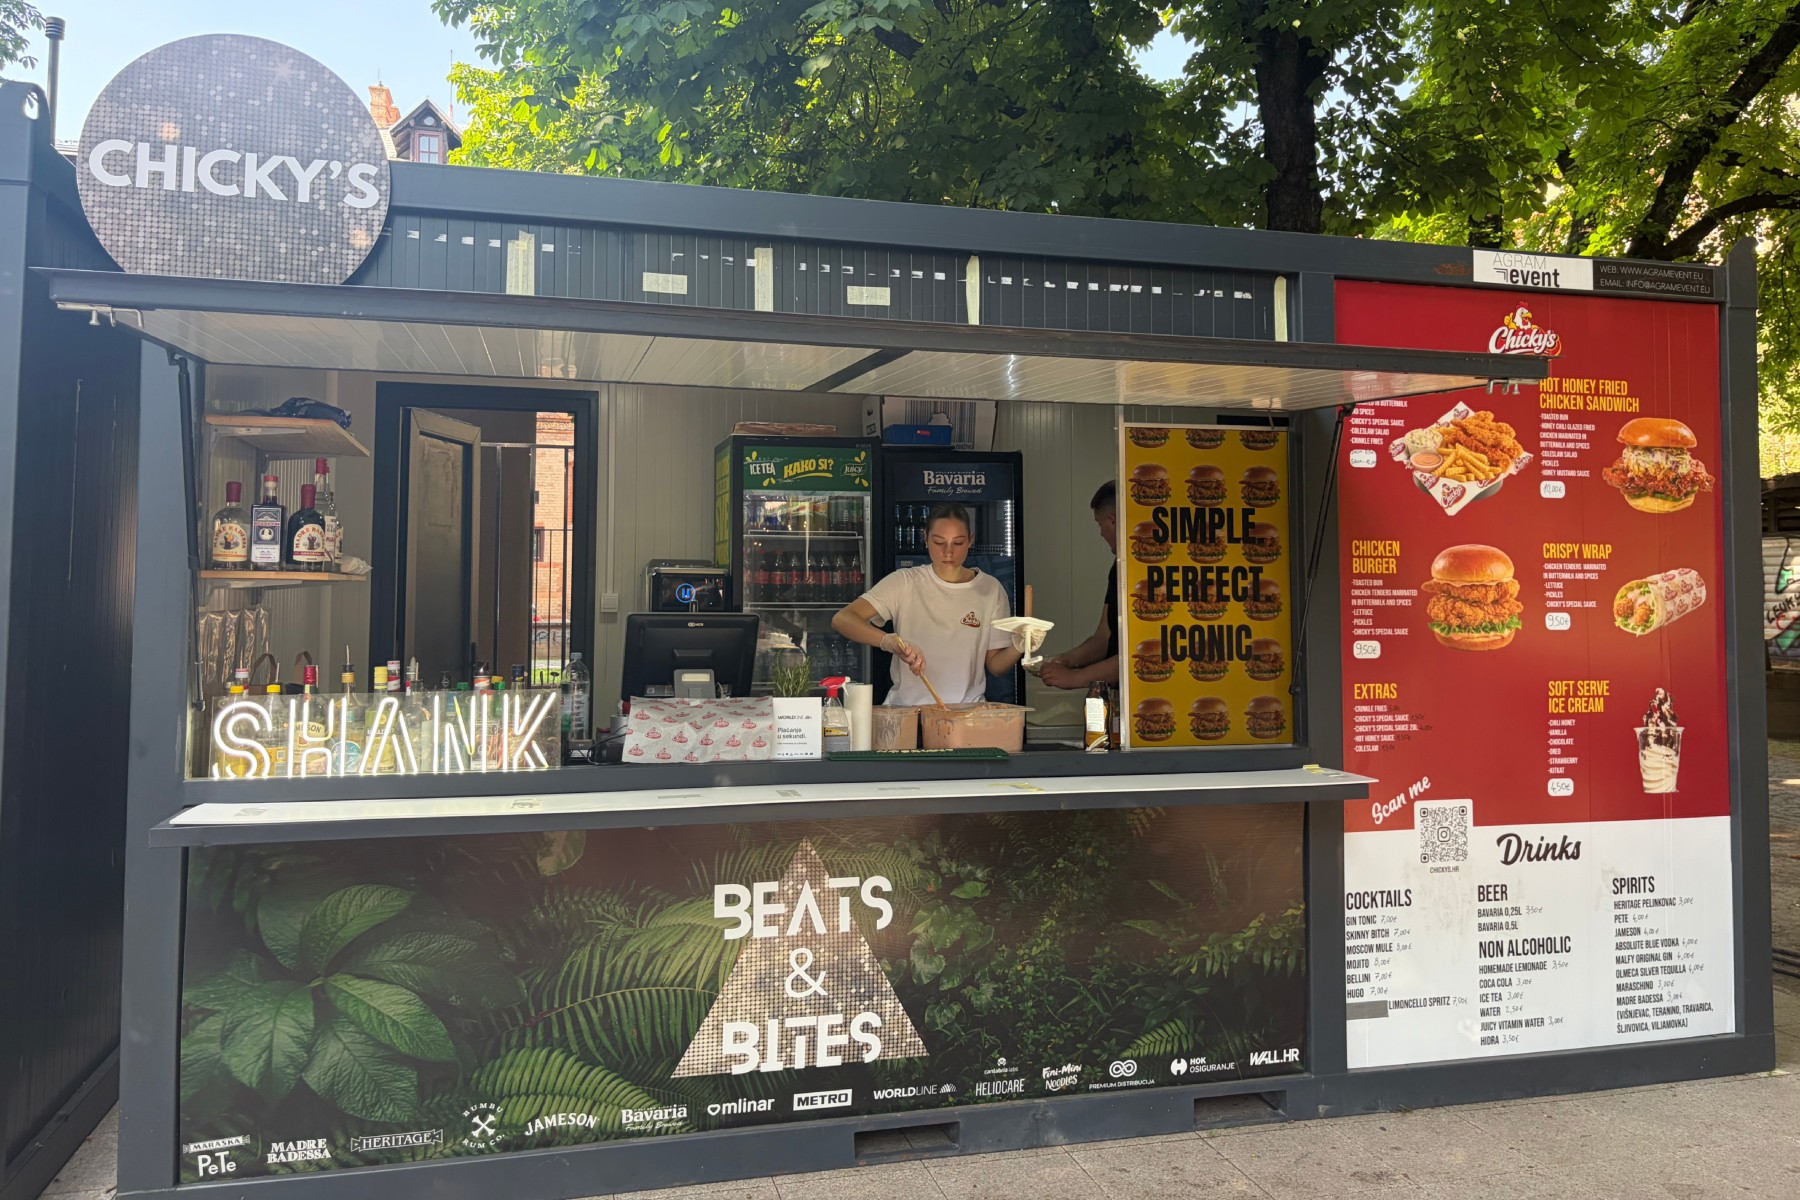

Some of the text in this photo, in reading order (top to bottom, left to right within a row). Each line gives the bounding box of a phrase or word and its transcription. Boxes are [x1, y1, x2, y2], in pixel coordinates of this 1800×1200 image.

[89, 139, 379, 208] CHICKY'S
[1493, 253, 1546, 269] AGRAM
[1510, 268, 1560, 287] event
[1600, 265, 1703, 280] WEB: WWW.AGRAMEVENT.EU
[1600, 278, 1710, 293] EMAIL: INFO@AGRAMEVENT.EU
[1489, 326, 1556, 354] Chicky's
[1540, 378, 1627, 395] HOT HONEY FRIED
[1540, 394, 1639, 412] CHICKEN SANDWICH
[784, 459, 834, 478] KAKO SI?
[923, 471, 986, 485] Bavaria
[928, 487, 954, 496] Family
[1352, 540, 1400, 556] CHICKEN
[1543, 543, 1612, 559] CRISPY WRAP
[1353, 558, 1397, 574] BURGER
[1354, 683, 1397, 699] EXTRAS
[1549, 681, 1609, 696] SOFT SERVE
[1549, 697, 1604, 713] ICE CREAM
[214, 692, 556, 779] SHANK
[1372, 776, 1431, 824] Scan me
[1497, 833, 1581, 865] Drinks
[1613, 876, 1655, 894] SPIRITS
[1346, 889, 1412, 910] COCKTAILS
[1478, 884, 1508, 902] BEER
[714, 875, 893, 940] BEATS
[1614, 897, 1676, 909] HERITAGE PELINKOVAC
[1478, 907, 1522, 917] BAVARIA 0,25L
[1615, 914, 1628, 923] PETE
[1346, 915, 1376, 926] GIN TONIC
[1478, 921, 1518, 932] BAVARIA 0,5L
[1346, 929, 1389, 940] SKINNY BITCH
[1615, 927, 1641, 937] JAMESON
[1347, 943, 1393, 955] MOSCOW MULE
[1479, 936, 1571, 958] NON ALCOHOLIC
[1615, 938, 1679, 951] ABSOLUTE BLUE VODKA
[1347, 959, 1369, 969] MOJITO
[1616, 952, 1672, 964] MALFY ORIGINAL GIN
[785, 948, 828, 997] &
[1479, 961, 1547, 974] HOMEMADE LEMONADE
[1616, 964, 1686, 978] OLMECA SILVER TEQUILLA
[1347, 973, 1370, 984] BELLINI
[1480, 978, 1512, 988] COCA COLA
[1347, 988, 1364, 998] HUGO
[1617, 981, 1653, 992] MARASCHINO
[1389, 996, 1450, 1009] LIMONCELLO SPRITZ
[1480, 993, 1502, 1003] ICE TEA
[1617, 993, 1663, 1006] MADRE BADESSA
[1480, 1007, 1500, 1017] WATER
[1480, 1018, 1544, 1031] JUICY VITAMIN WATER
[722, 1011, 882, 1075] BITES
[1481, 1036, 1499, 1046] HIDRA
[1190, 1057, 1206, 1065] HOK
[1249, 1048, 1299, 1065] WALL.HR
[1190, 1061, 1234, 1073] OSIGURANJE
[975, 1078, 1025, 1096] HELIOCARE
[1045, 1075, 1078, 1091] NOODLES
[1117, 1079, 1155, 1087] DISTRIBUCIJA
[797, 1092, 848, 1107] METRO
[873, 1084, 937, 1100] WORLDLINE
[723, 1098, 775, 1114] mlinar
[622, 1104, 687, 1124] Bavaria
[525, 1113, 597, 1135] JAMESON
[193, 1138, 240, 1150] MARASKA
[271, 1138, 327, 1152] MADRE
[363, 1133, 432, 1148] HERITAGE
[463, 1138, 485, 1149] RUM
[267, 1148, 331, 1164] BADESSA
[198, 1151, 236, 1177] PeTe
